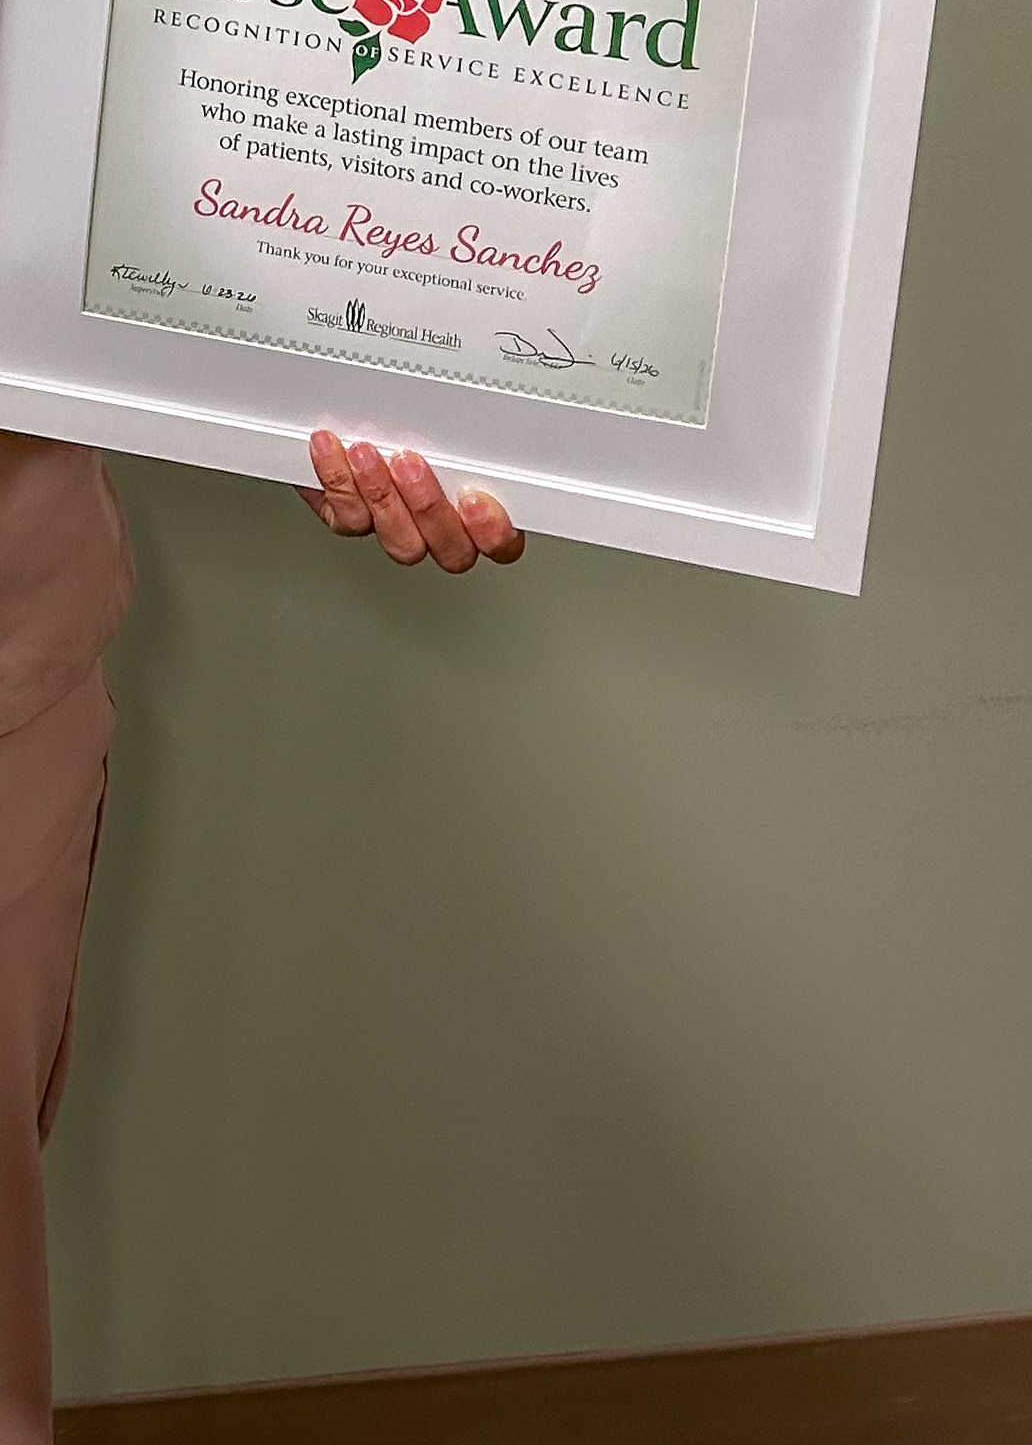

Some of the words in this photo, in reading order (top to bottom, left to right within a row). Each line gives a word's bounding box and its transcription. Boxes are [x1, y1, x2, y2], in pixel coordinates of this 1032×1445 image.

[153, 8, 343, 53] RECOGNITION
[355, 44, 380, 59] OF
[387, 46, 500, 79] SERVICE
[514, 66, 690, 110] EXCELLENCE
[179, 68, 279, 107] Honoring
[285, 89, 406, 123] exceptional
[414, 112, 513, 142] members
[520, 128, 543, 146] of
[549, 135, 587, 154] our
[594, 140, 648, 165] team
[201, 103, 246, 124] who
[252, 113, 308, 135] make
[315, 124, 326, 138] a
[333, 122, 404, 156] lasting
[410, 136, 484, 165] impact
[491, 154, 519, 172] on
[529, 156, 564, 179] the
[571, 162, 619, 188] lives
[219, 133, 243, 151] of
[246, 138, 333, 171] patients,
[341, 155, 416, 183] visitors
[421, 171, 463, 191] and
[470, 178, 591, 213] co-workers.
[194, 178, 330, 235] Sandra
[339, 204, 440, 259] Reyes
[450, 224, 603, 295] Sanchez
[257, 239, 301, 260] Thank
[305, 251, 330, 265] you
[334, 255, 354, 270] for
[357, 262, 389, 275] your
[392, 267, 472, 292] exceptional
[306, 307, 344, 328] Skagit
[366, 318, 418, 339] Regional
[420, 328, 462, 349] Health
